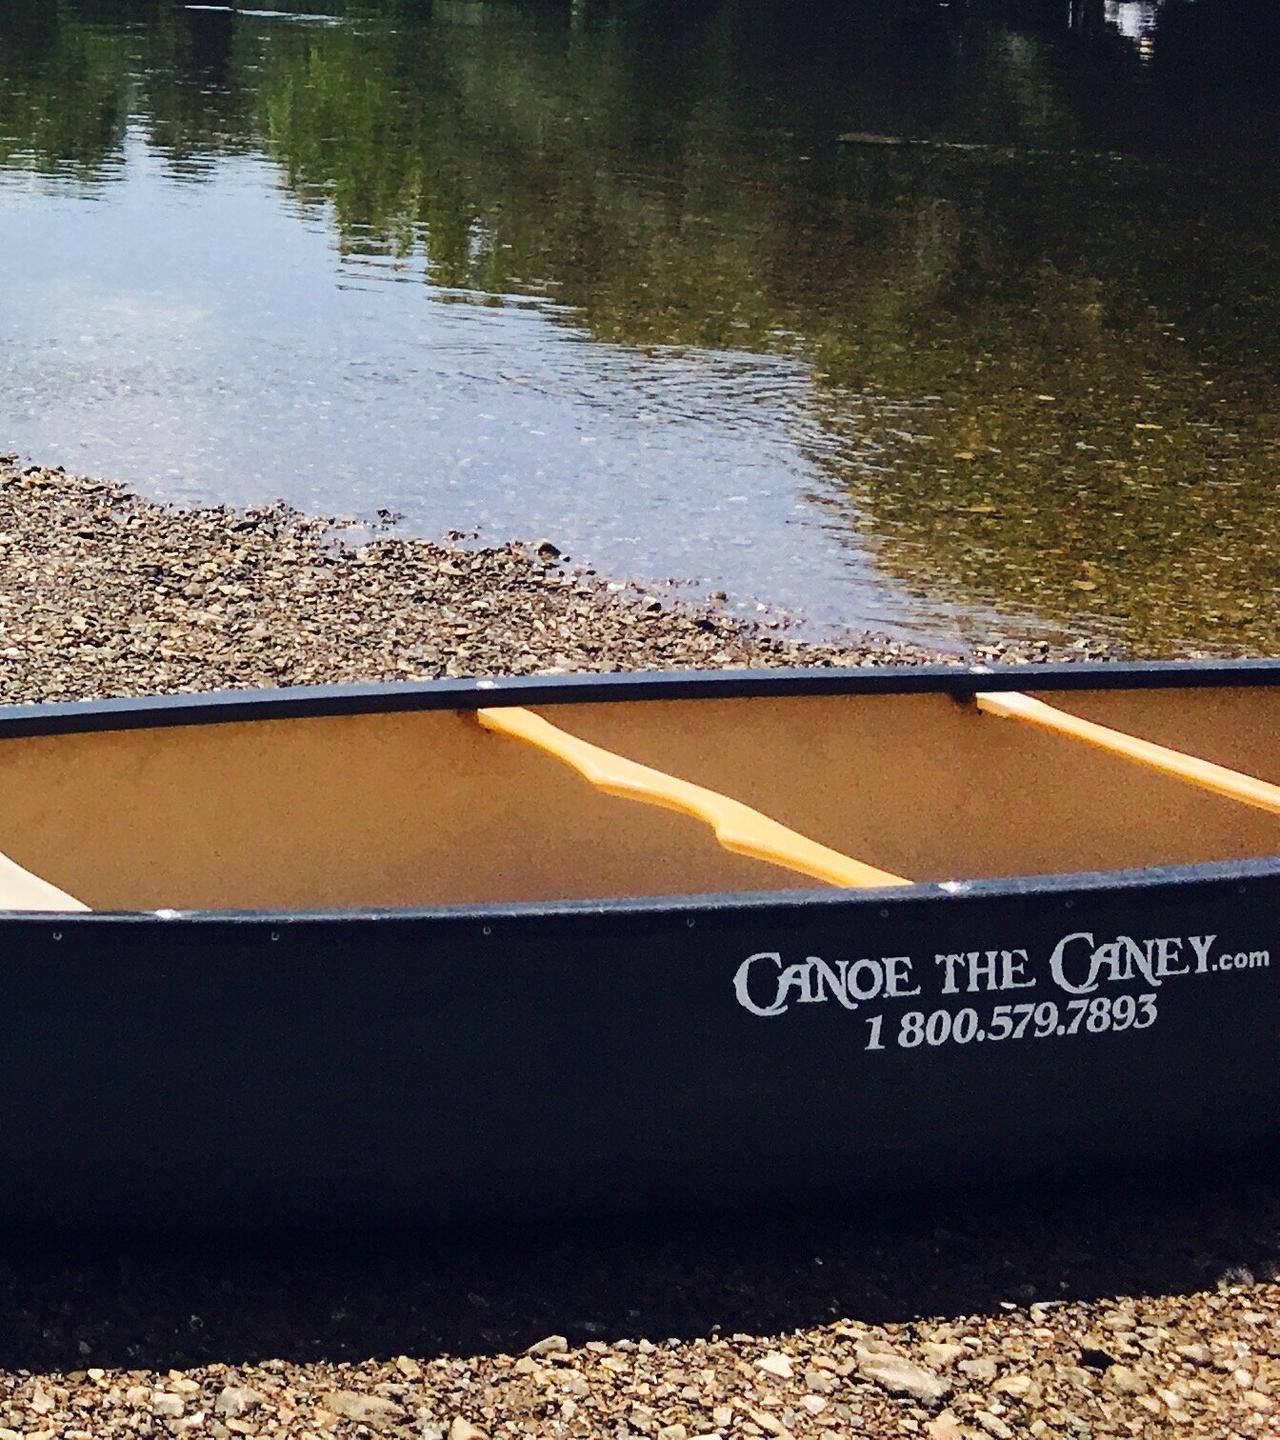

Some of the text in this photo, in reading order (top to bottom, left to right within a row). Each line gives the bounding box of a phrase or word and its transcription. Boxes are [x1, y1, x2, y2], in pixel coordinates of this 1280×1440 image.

[732, 951, 922, 1017] CANOE
[934, 949, 1037, 996] THE
[863, 992, 1159, 1051] 1 800.579.7893
